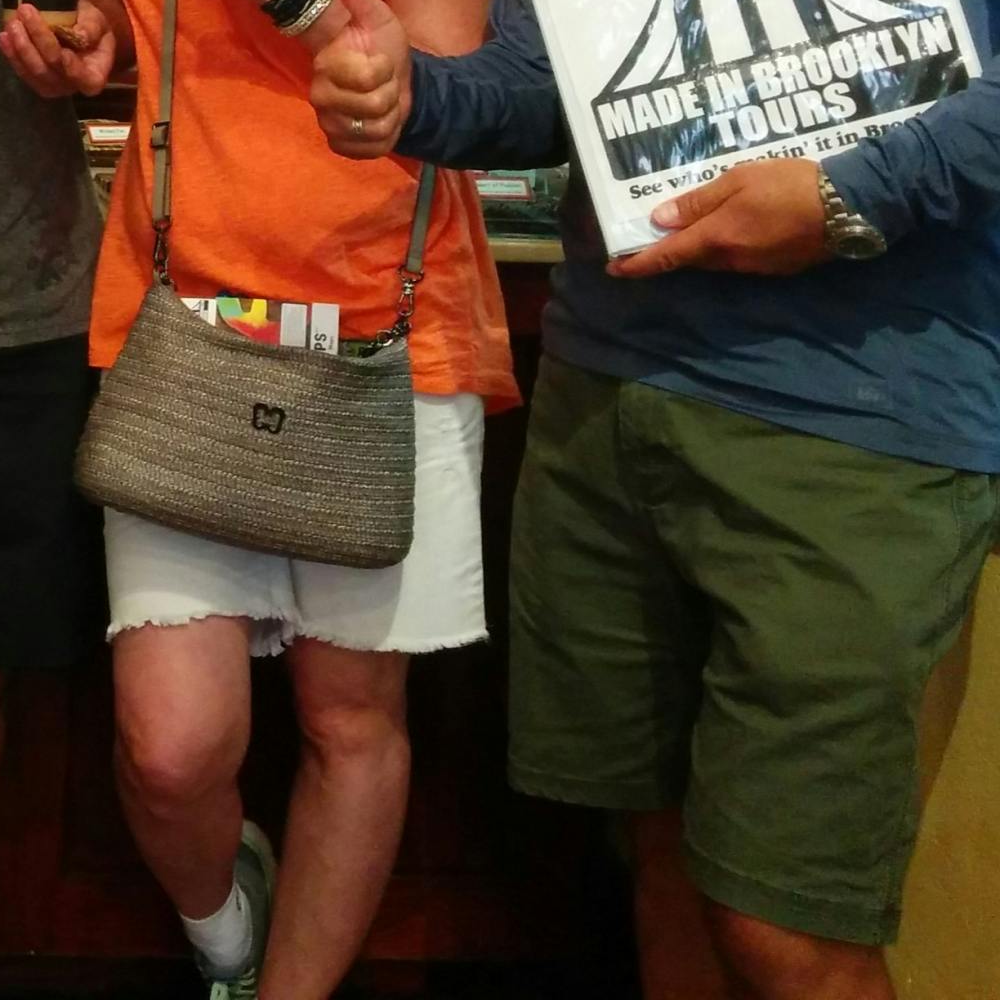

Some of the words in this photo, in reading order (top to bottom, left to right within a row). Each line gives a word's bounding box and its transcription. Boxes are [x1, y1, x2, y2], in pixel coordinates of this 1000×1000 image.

[597, 79, 704, 139] MADE
[706, 68, 750, 112] IN
[753, 16, 955, 97] BROOKLYN
[709, 81, 857, 148] TOURS
[629, 181, 662, 199] See
[816, 134, 832, 152] it
[838, 128, 859, 147] in
